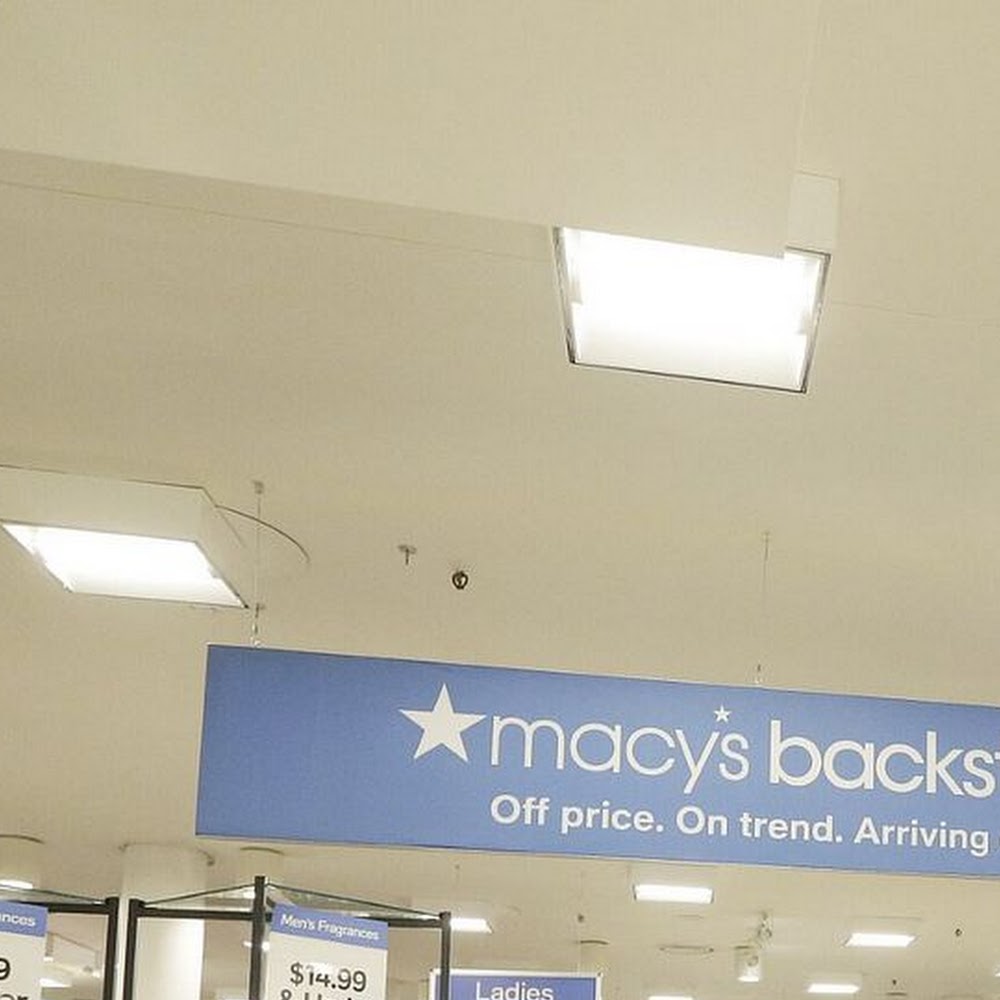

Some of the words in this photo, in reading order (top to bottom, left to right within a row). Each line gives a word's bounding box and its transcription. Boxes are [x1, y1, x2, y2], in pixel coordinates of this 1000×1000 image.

[490, 793, 550, 825] Off
[561, 800, 664, 834] price.
[676, 805, 728, 836] On
[740, 811, 843, 843] trend.
[854, 816, 989, 857] Arriving
[280, 913, 315, 931] Men's
[317, 920, 379, 941] Fragrances
[290, 961, 367, 993] $14.99
